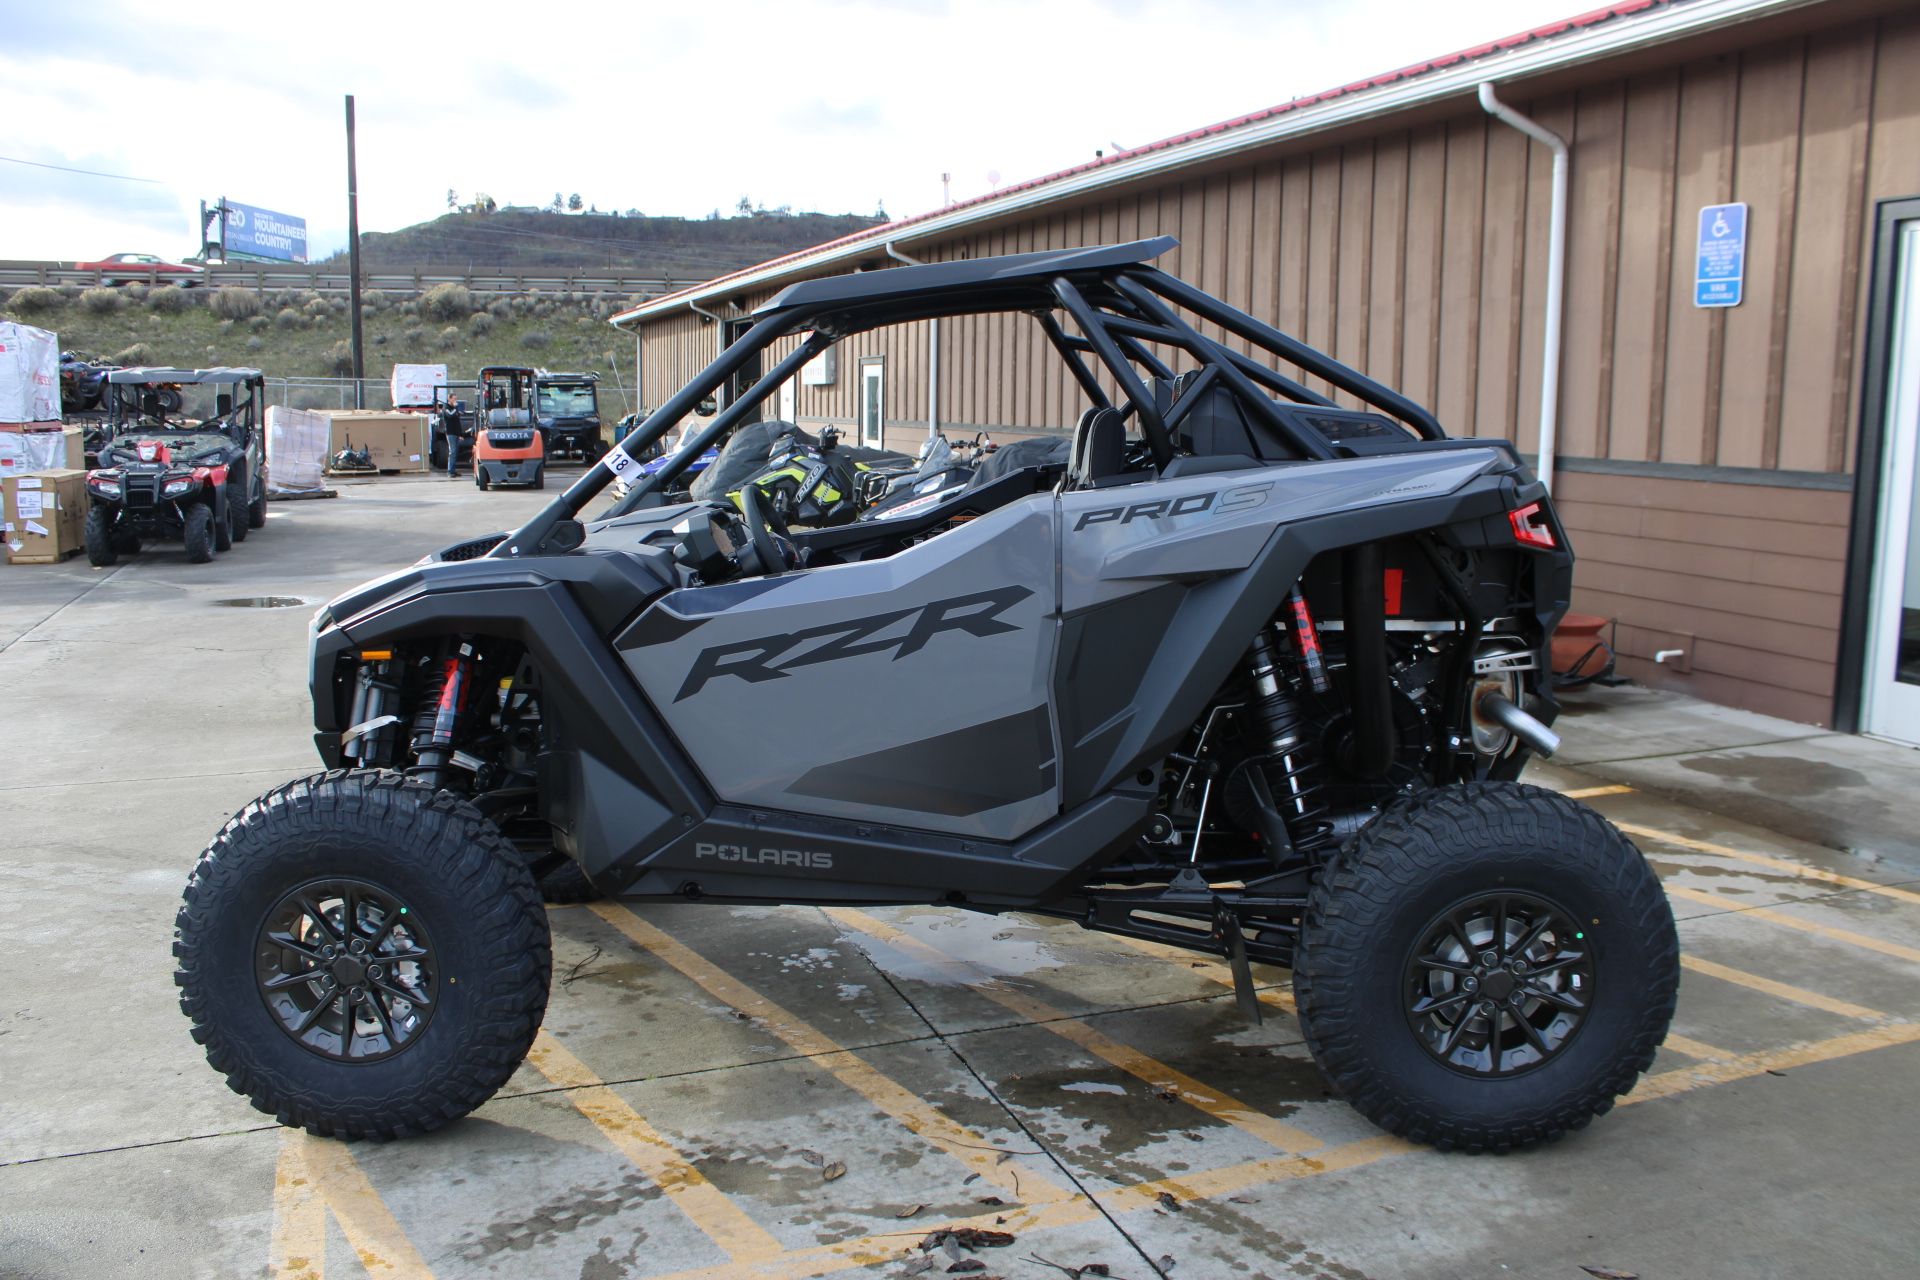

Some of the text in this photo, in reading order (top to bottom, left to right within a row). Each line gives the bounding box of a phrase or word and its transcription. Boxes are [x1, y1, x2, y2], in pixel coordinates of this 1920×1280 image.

[254, 217, 306, 240] MOUNTAINEER
[255, 232, 292, 251] COUNTRY!
[796, 463, 822, 504] PRO
[1072, 491, 1218, 532] PRO
[672, 584, 1036, 705] RZR
[695, 842, 833, 869] POLARIS
